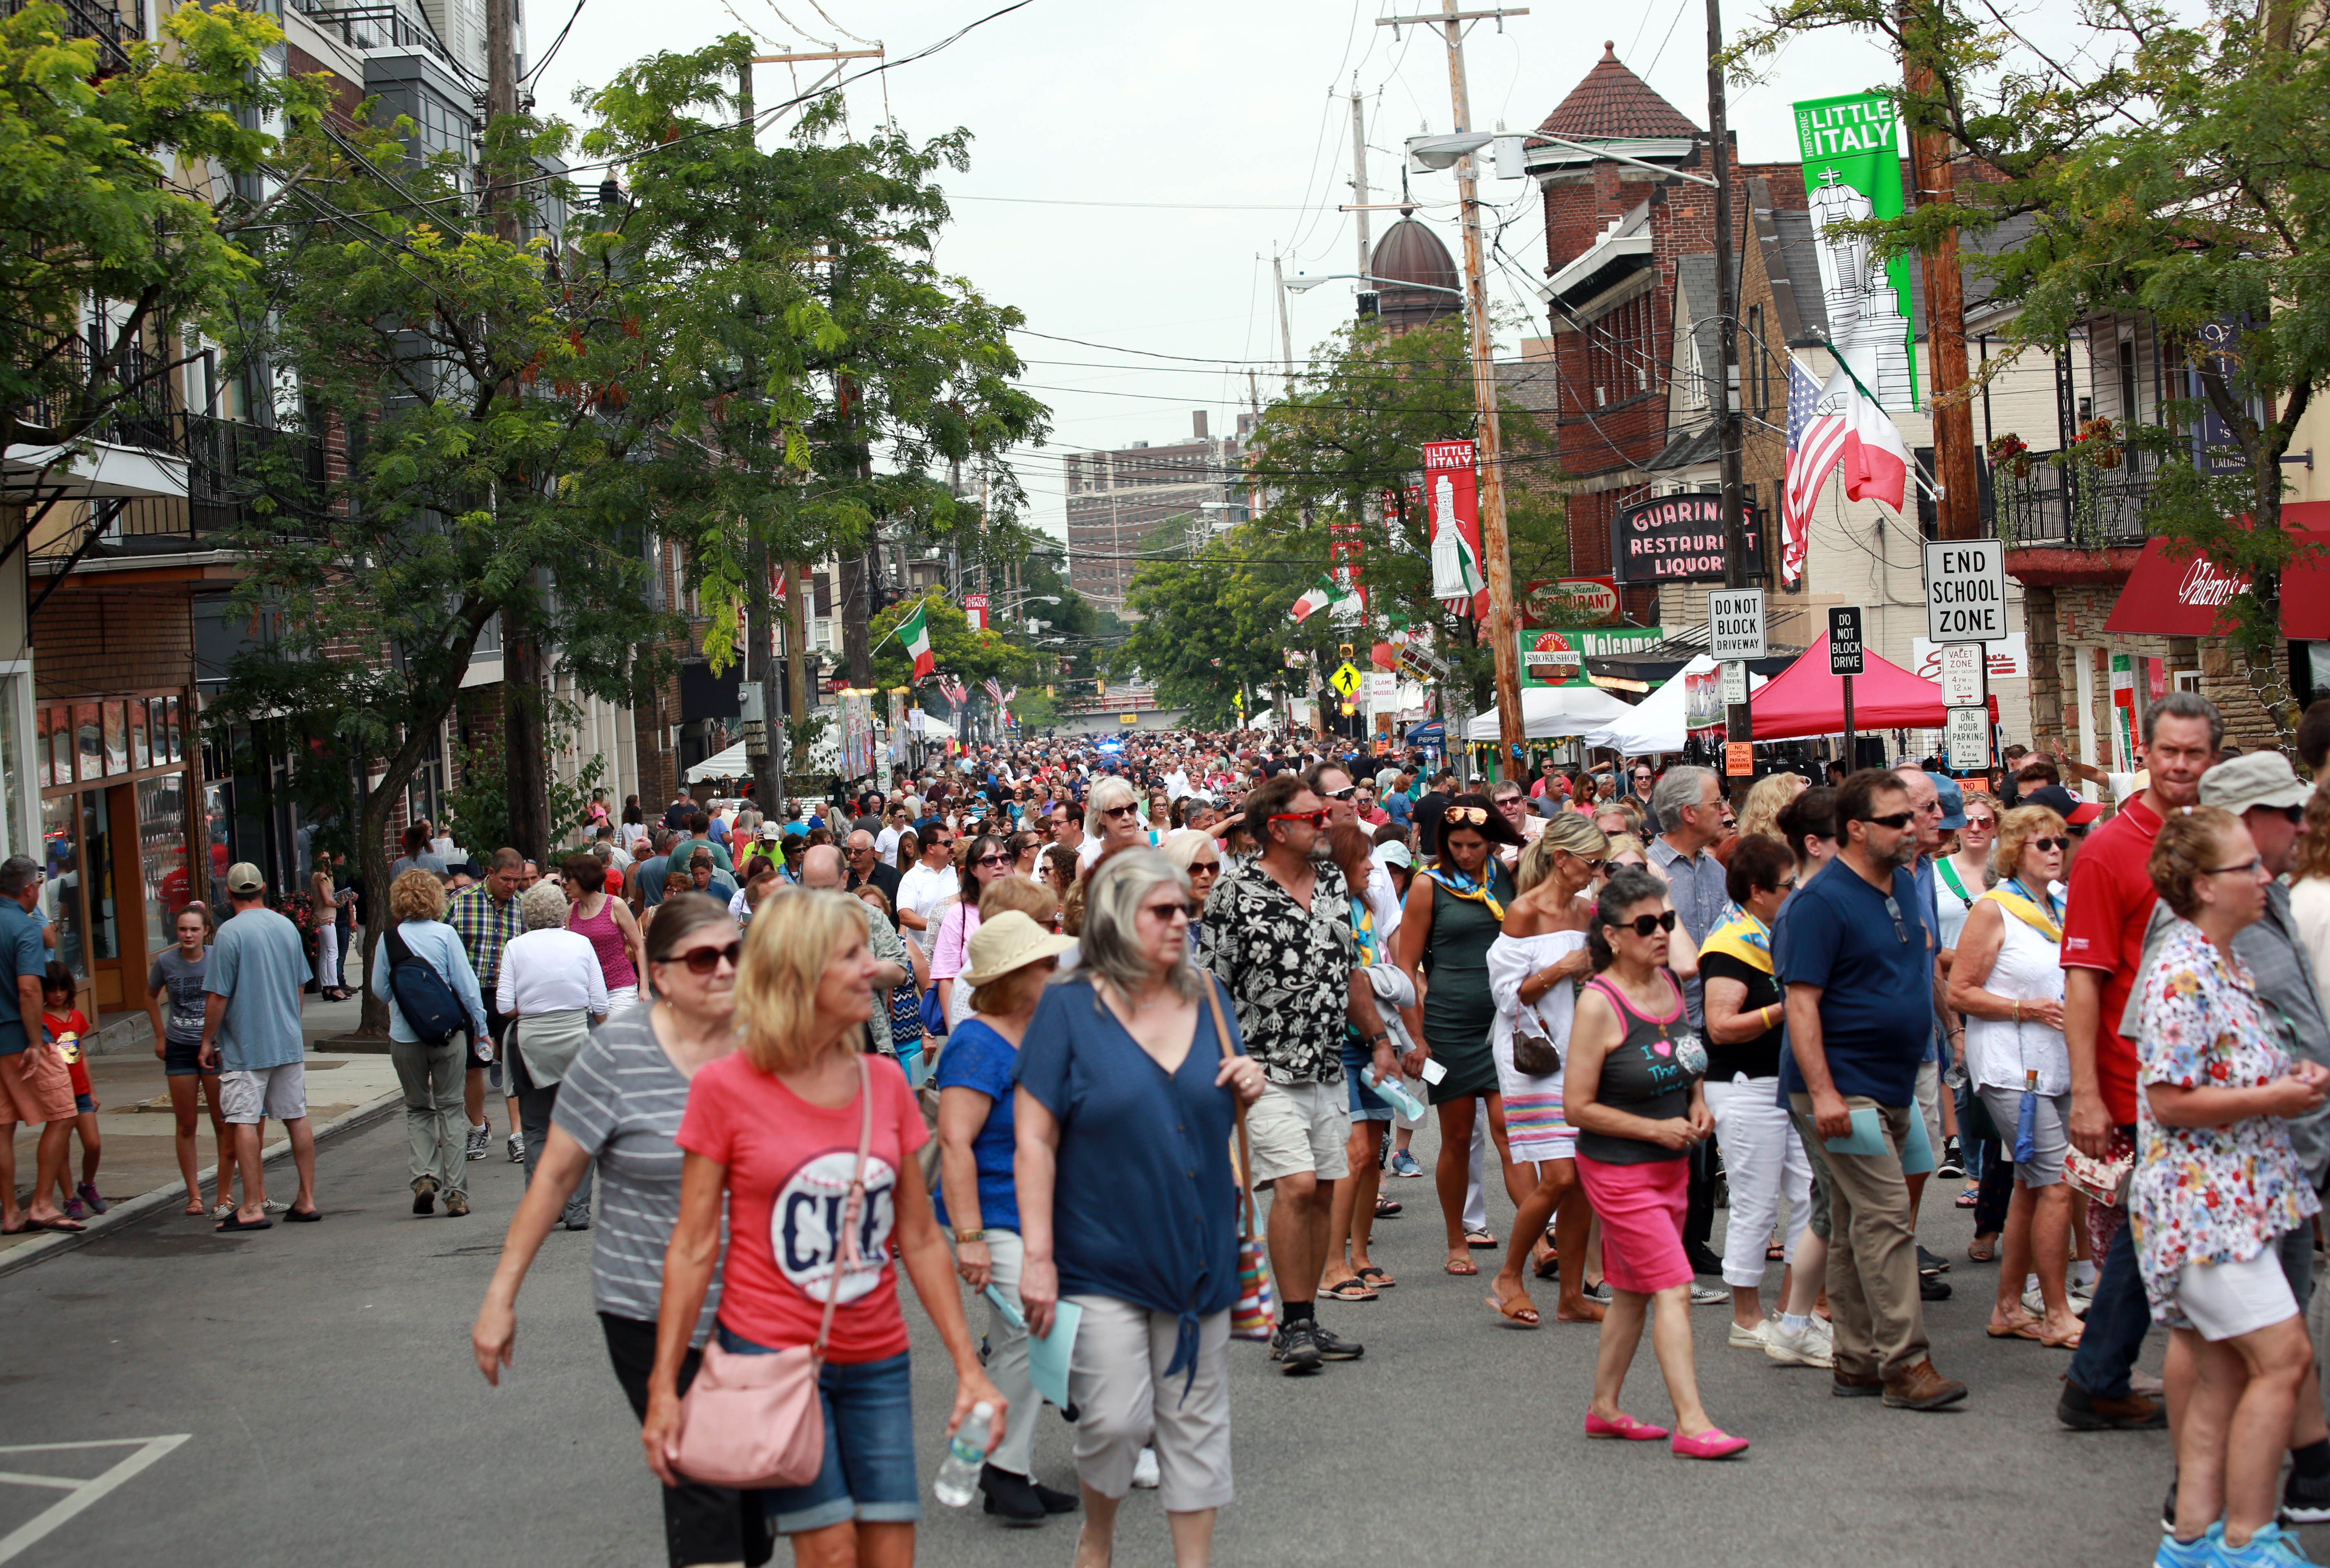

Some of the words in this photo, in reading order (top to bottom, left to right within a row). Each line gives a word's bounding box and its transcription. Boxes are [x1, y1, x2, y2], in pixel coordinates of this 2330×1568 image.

[1811, 100, 1892, 129] LITTLE
[1799, 112, 1814, 157] HISTORIC
[1813, 121, 1892, 156] ITALY
[1432, 445, 1472, 457] LITTLE
[1432, 456, 1472, 468] ITALY
[1943, 551, 1985, 573] END
[1573, 584, 1601, 594] Santa
[1933, 579, 1999, 604] SCHOOL
[1716, 600, 1731, 615] DO
[1735, 599, 1757, 614] NOT
[1718, 619, 1757, 635] BLOCK
[1839, 614, 1851, 625] DO
[1940, 609, 1995, 632] ZONE
[1838, 628, 1854, 639] NOT
[1536, 634, 1568, 650] MAYFIELD
[1717, 639, 1759, 650] DRIVEWAY
[1832, 641, 1860, 654] BLOCK
[1527, 654, 1555, 662] SMOKE
[1557, 654, 1578, 662] SHOP
[1834, 656, 1859, 668] DRIVE
[1403, 661, 1425, 678] CORN
[1953, 733, 1984, 741] PARKING
[1640, 1045, 1654, 1060] I
[1647, 1065, 1678, 1082] The
